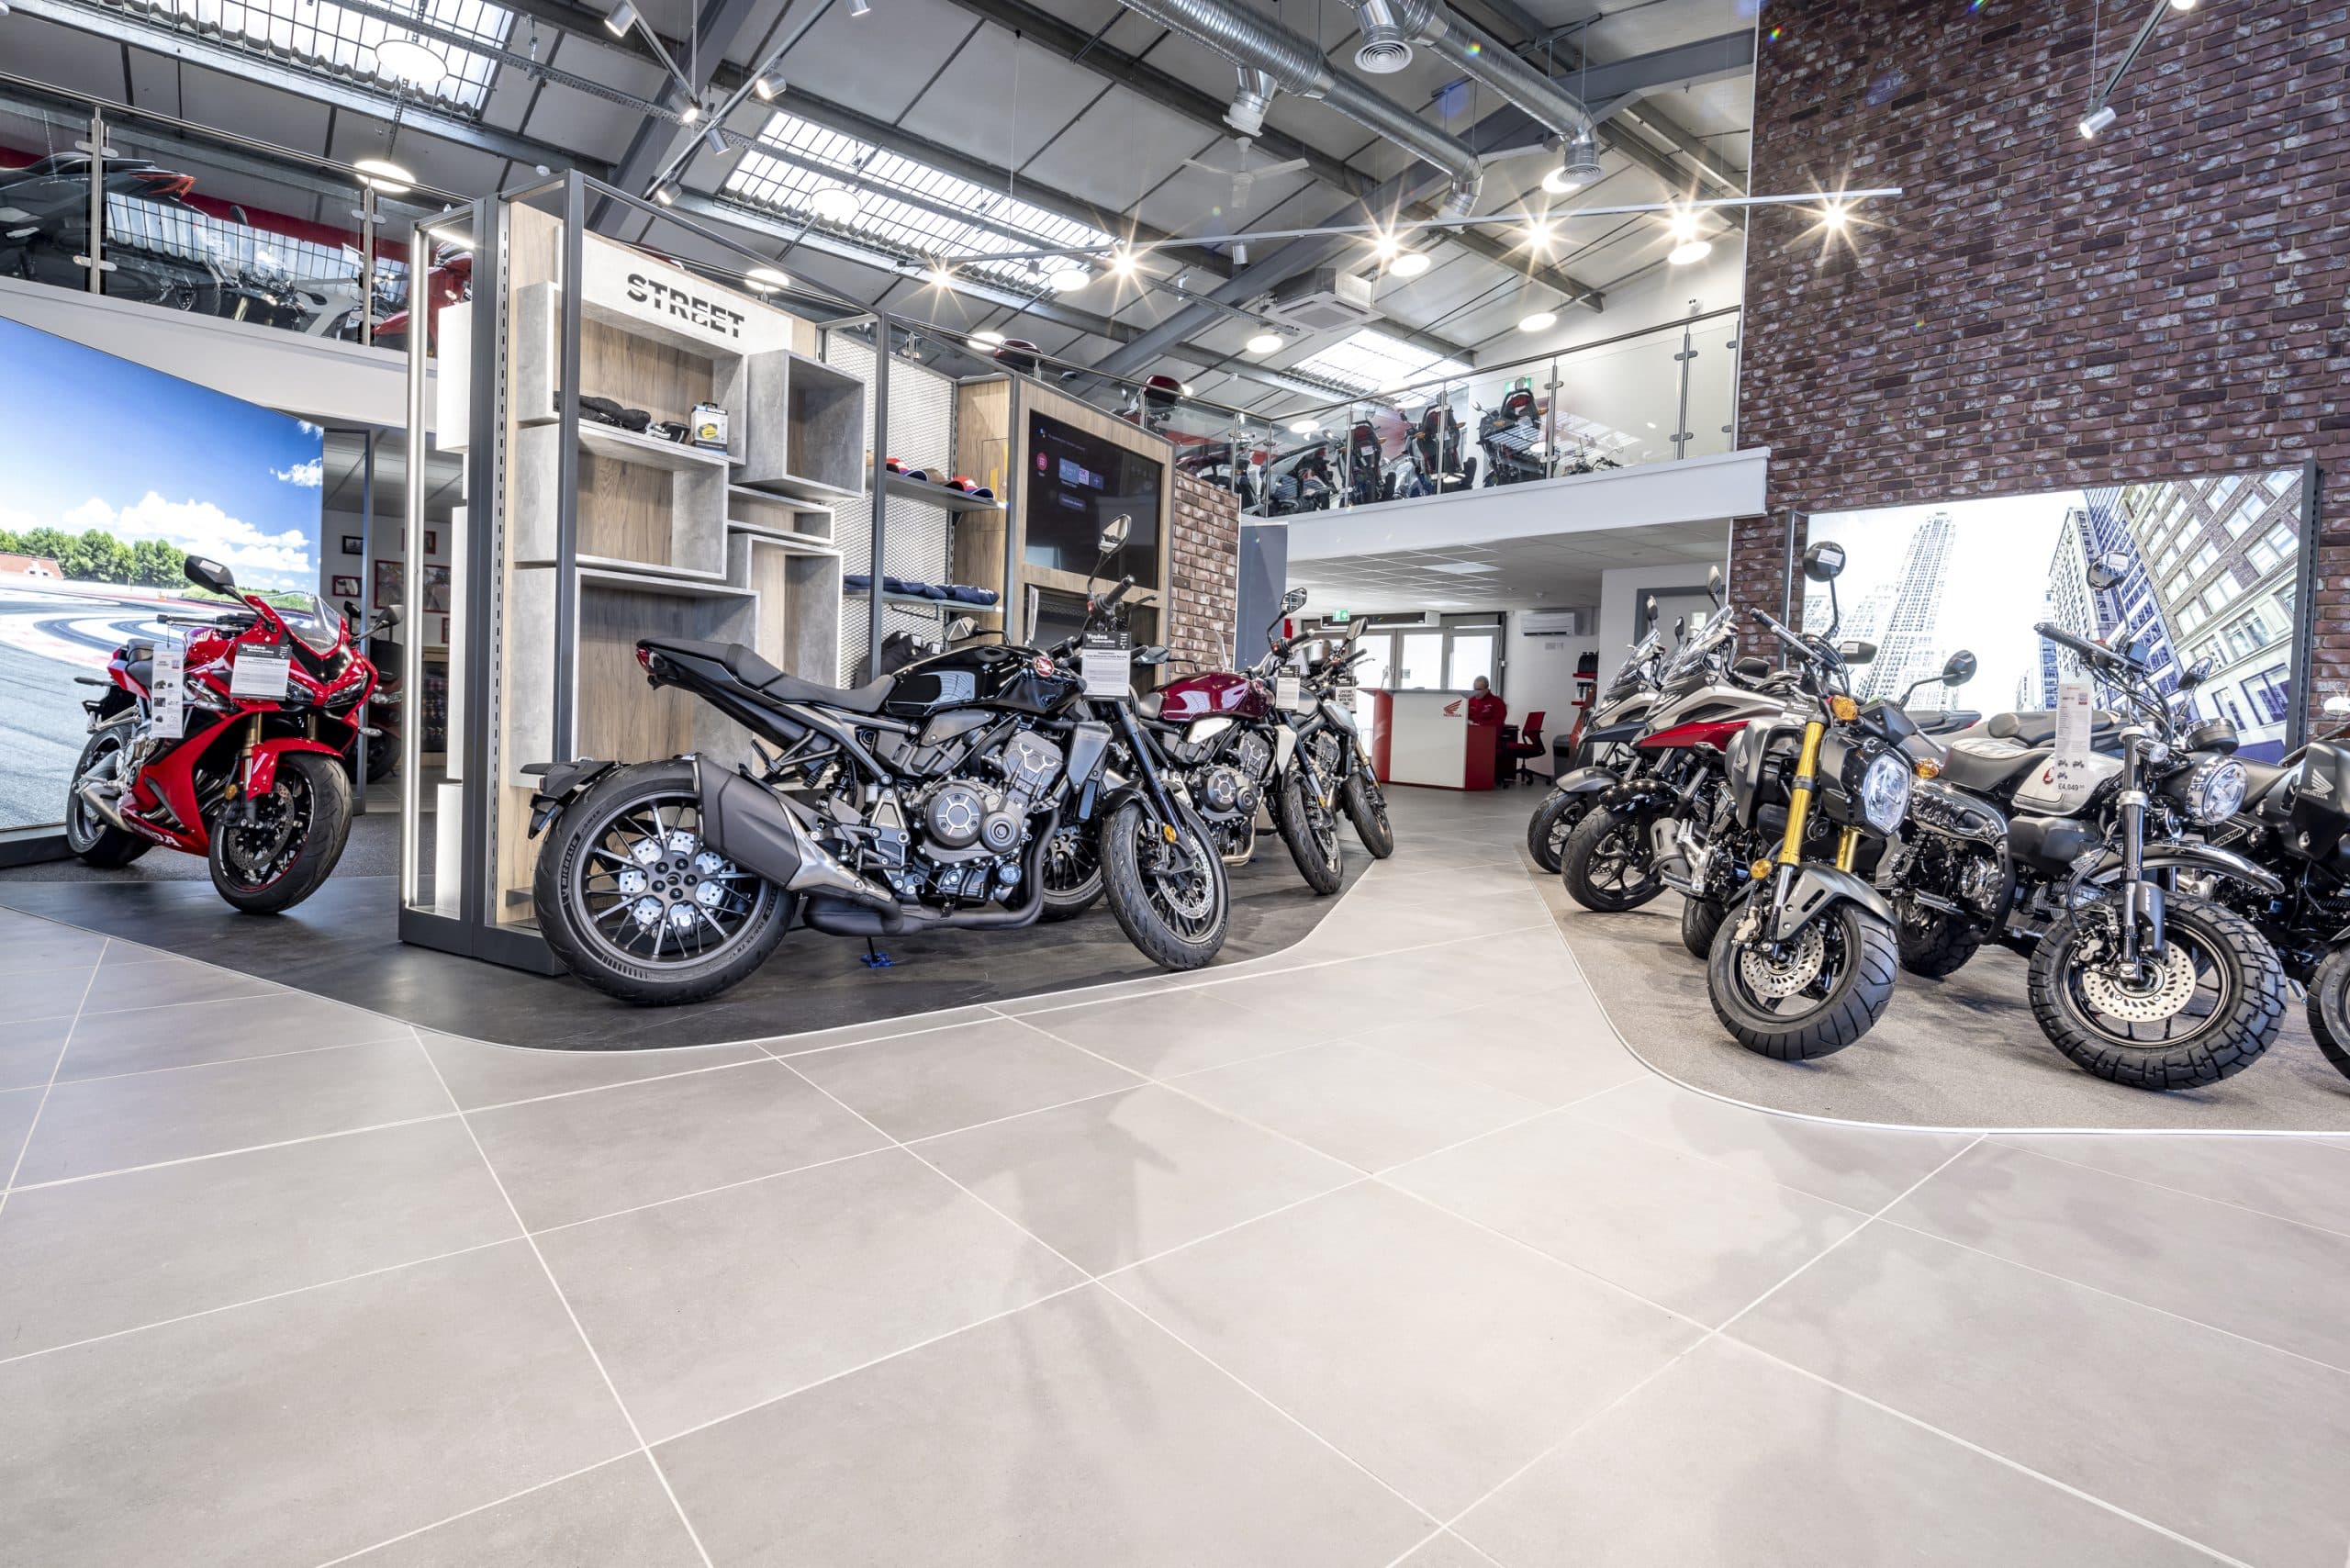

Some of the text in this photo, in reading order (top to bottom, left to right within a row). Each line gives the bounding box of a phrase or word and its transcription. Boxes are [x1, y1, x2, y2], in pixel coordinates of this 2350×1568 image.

[627, 274, 744, 338] STREET
[2300, 788, 2328, 800] HONDA
[560, 836, 578, 888] MICHELIN
